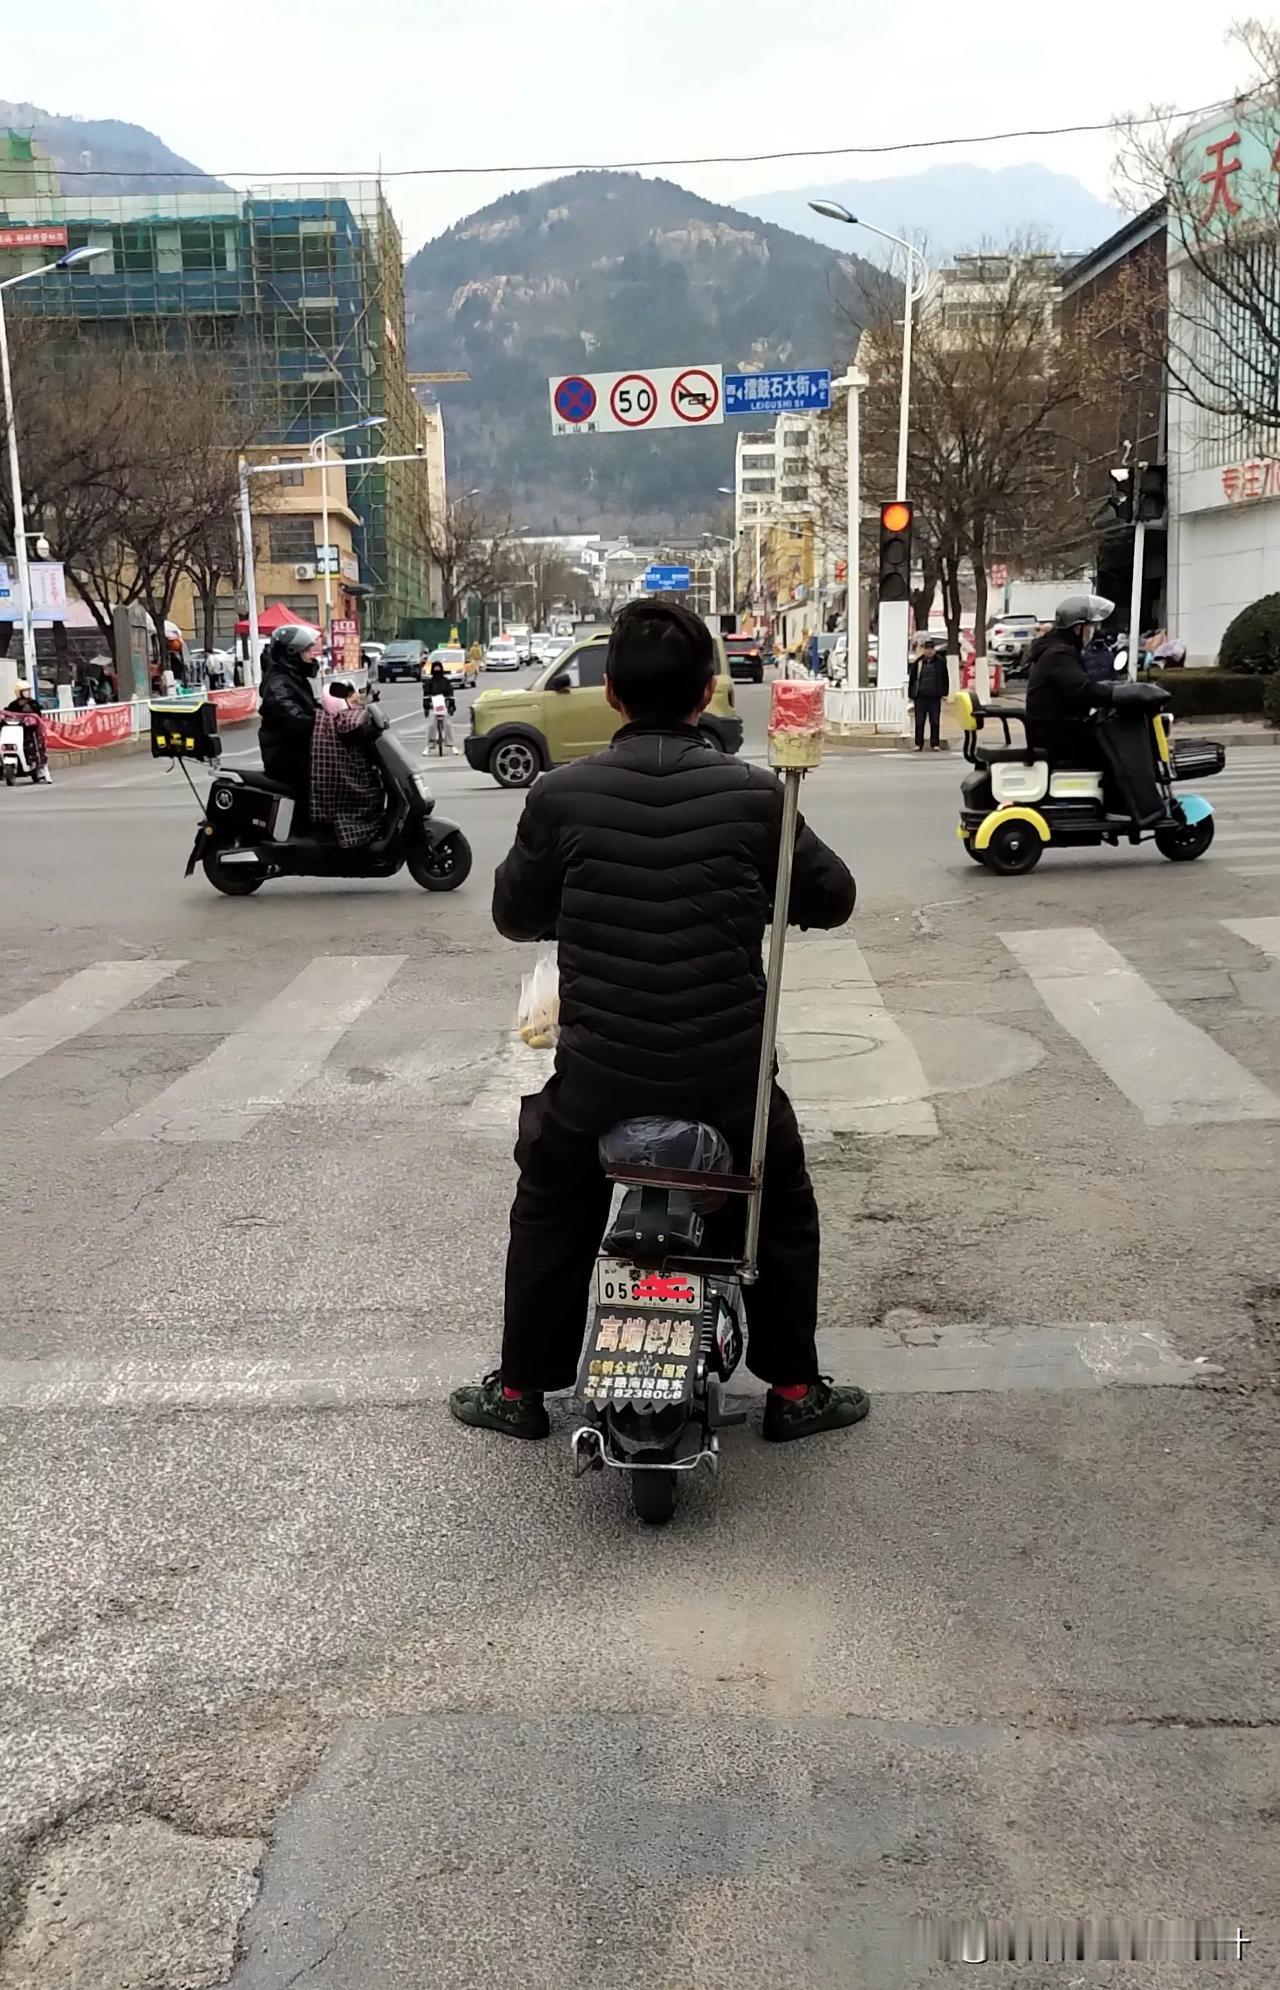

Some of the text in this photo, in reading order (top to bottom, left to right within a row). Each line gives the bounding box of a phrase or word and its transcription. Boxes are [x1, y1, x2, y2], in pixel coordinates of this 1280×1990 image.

[619, 388, 651, 413] 50
[744, 375, 811, 401] 擂鼓石大街
[595, 1315, 694, 1357] 高端制造
